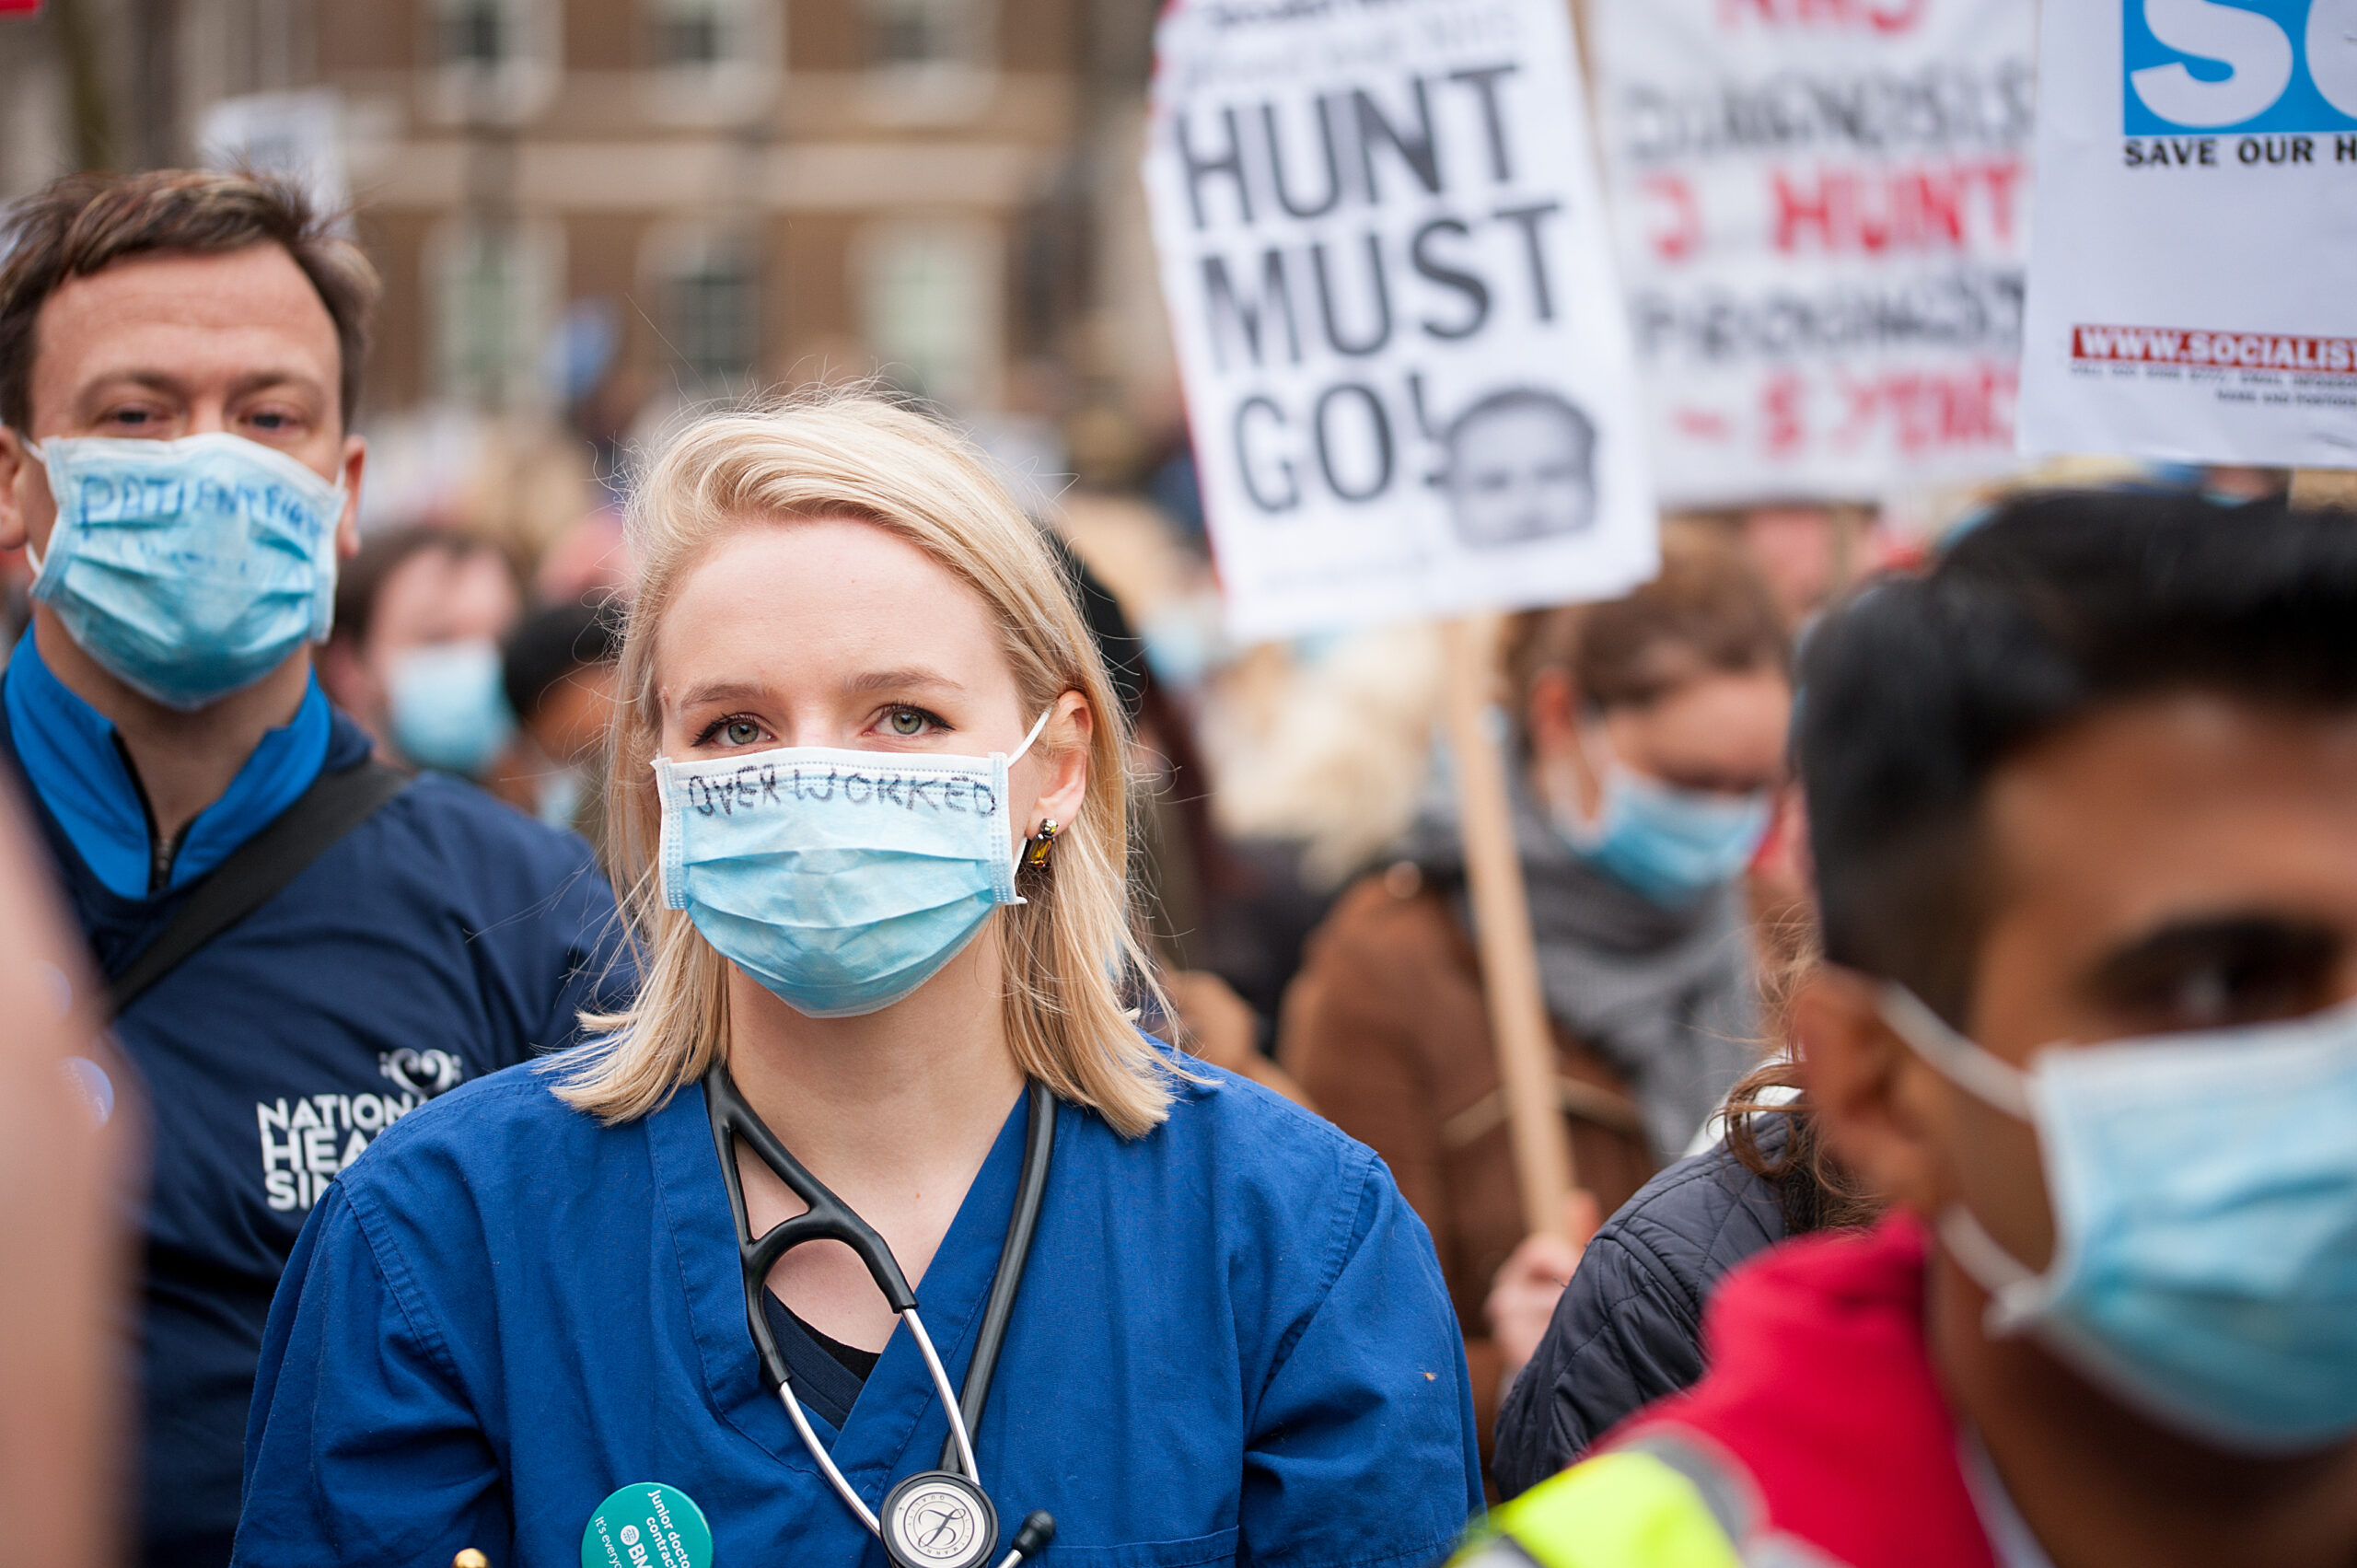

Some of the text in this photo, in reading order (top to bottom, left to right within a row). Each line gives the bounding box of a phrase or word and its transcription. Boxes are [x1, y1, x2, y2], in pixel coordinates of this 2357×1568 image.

[1176, 64, 1520, 229] HUNT
[2124, 137, 2217, 167] SAVE
[2238, 136, 2315, 165] OUR
[1771, 157, 2028, 256] HUNT
[1199, 202, 1564, 373] MUST
[1234, 372, 1446, 514] GO!
[256, 1092, 429, 1132] NATION
[261, 1125, 384, 1175] HEA
[595, 1516, 608, 1534] It's
[647, 1489, 673, 1529] Junior
